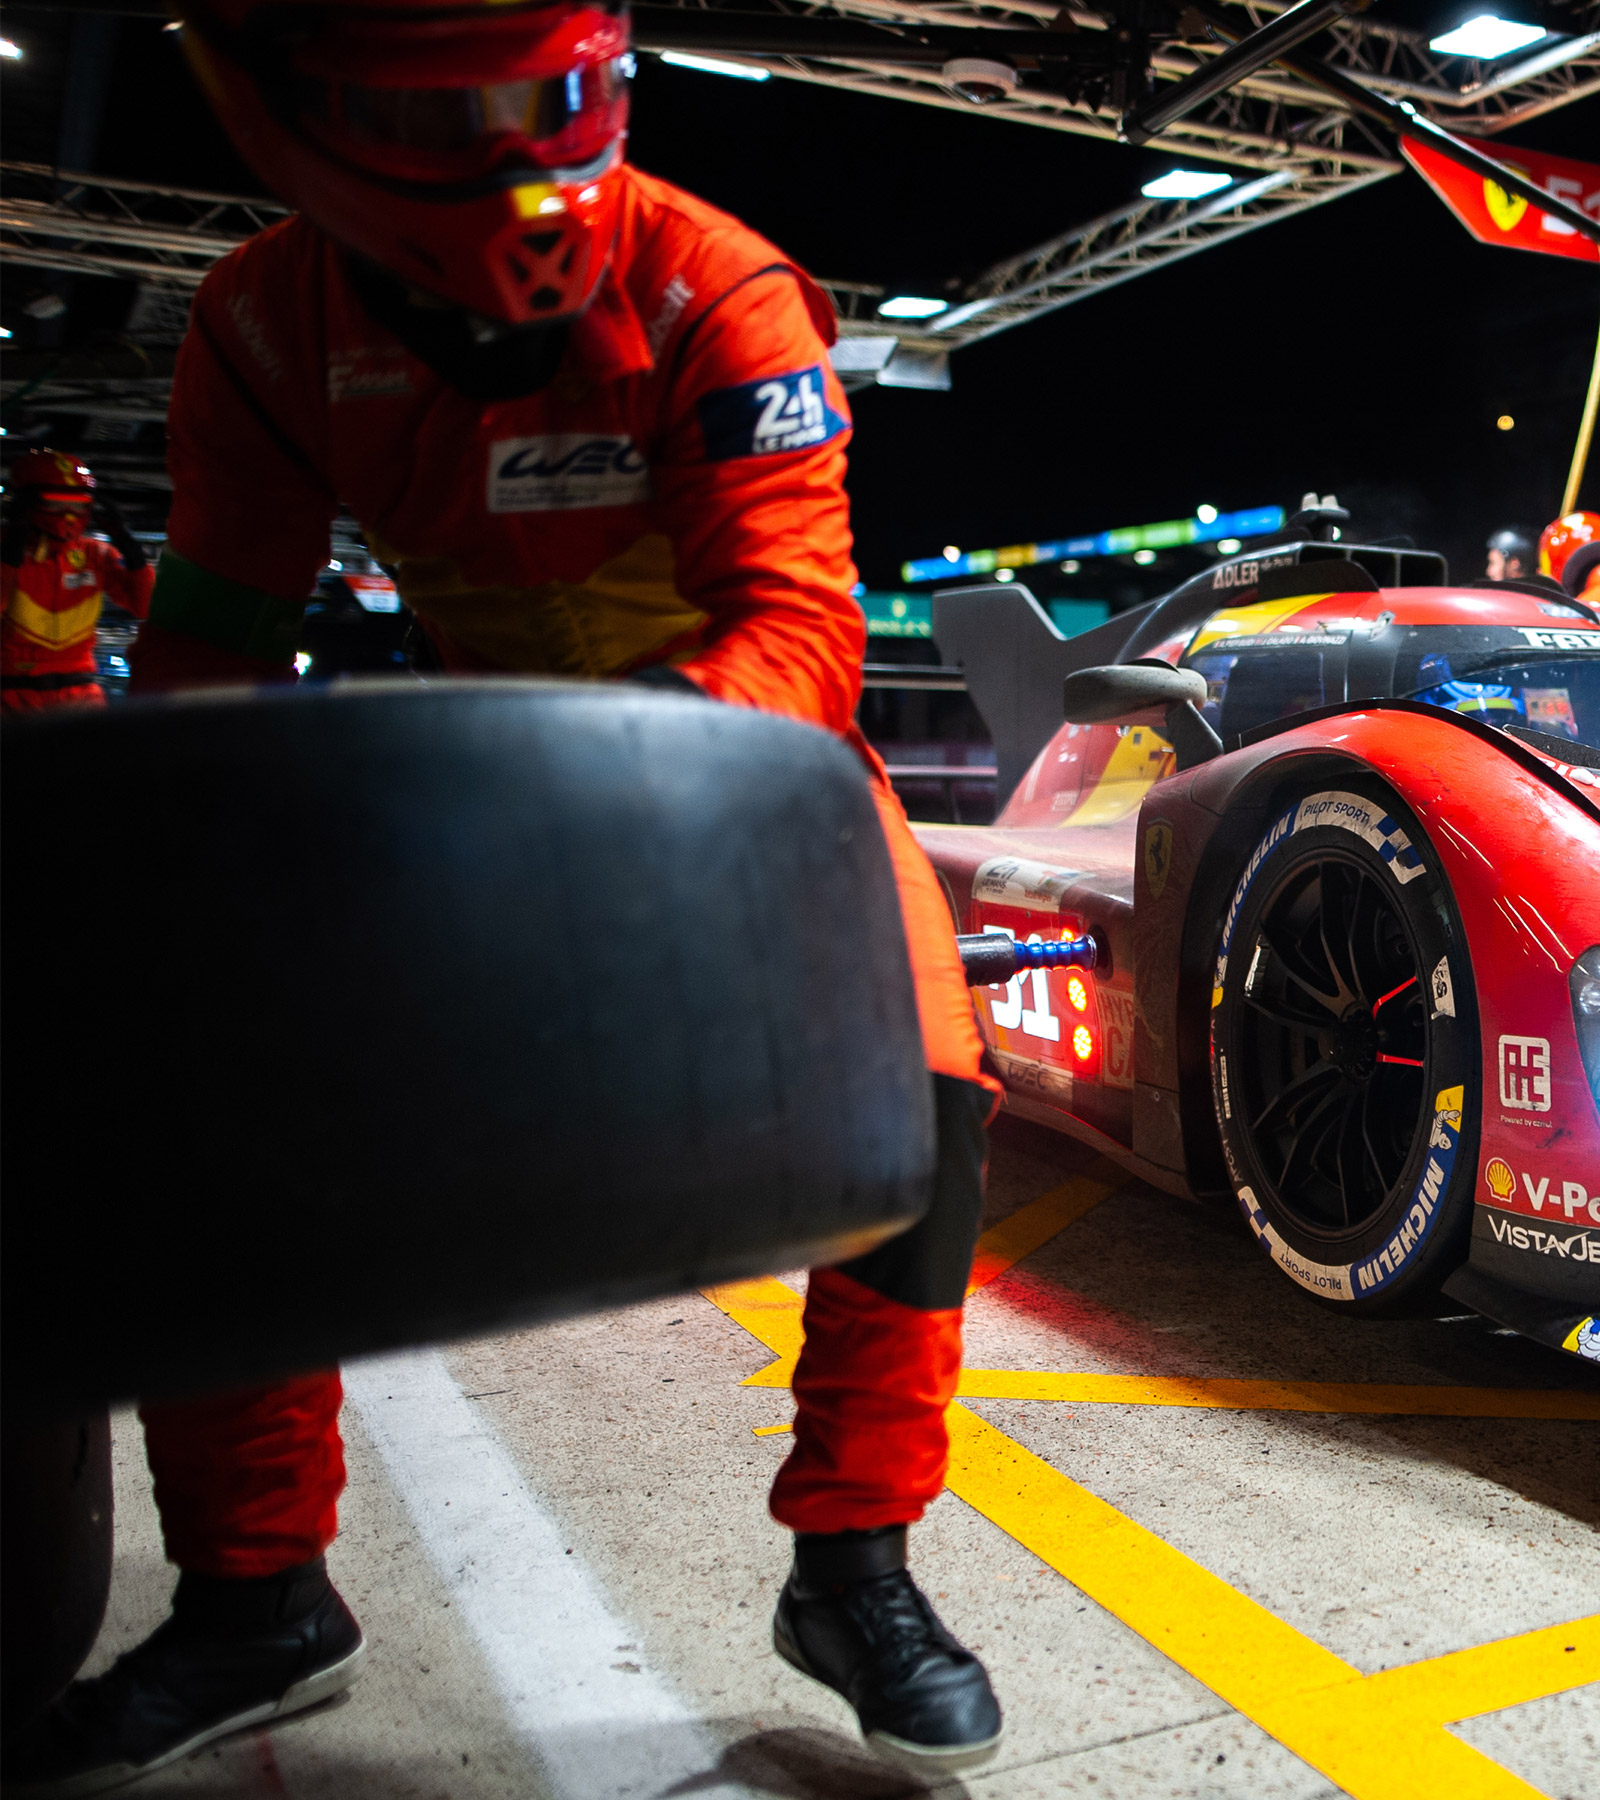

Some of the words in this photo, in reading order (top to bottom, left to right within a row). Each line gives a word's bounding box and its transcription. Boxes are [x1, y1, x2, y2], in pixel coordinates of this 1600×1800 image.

[1212, 560, 1259, 589] ADLER
[1304, 801, 1334, 817] PILOT
[1333, 801, 1371, 825] SPORT
[1221, 811, 1292, 949] MICHELIN
[1358, 1156, 1445, 1291] MICHELIN
[1279, 1253, 1312, 1282] SPORT
[1313, 1273, 1342, 1291] PILOT
